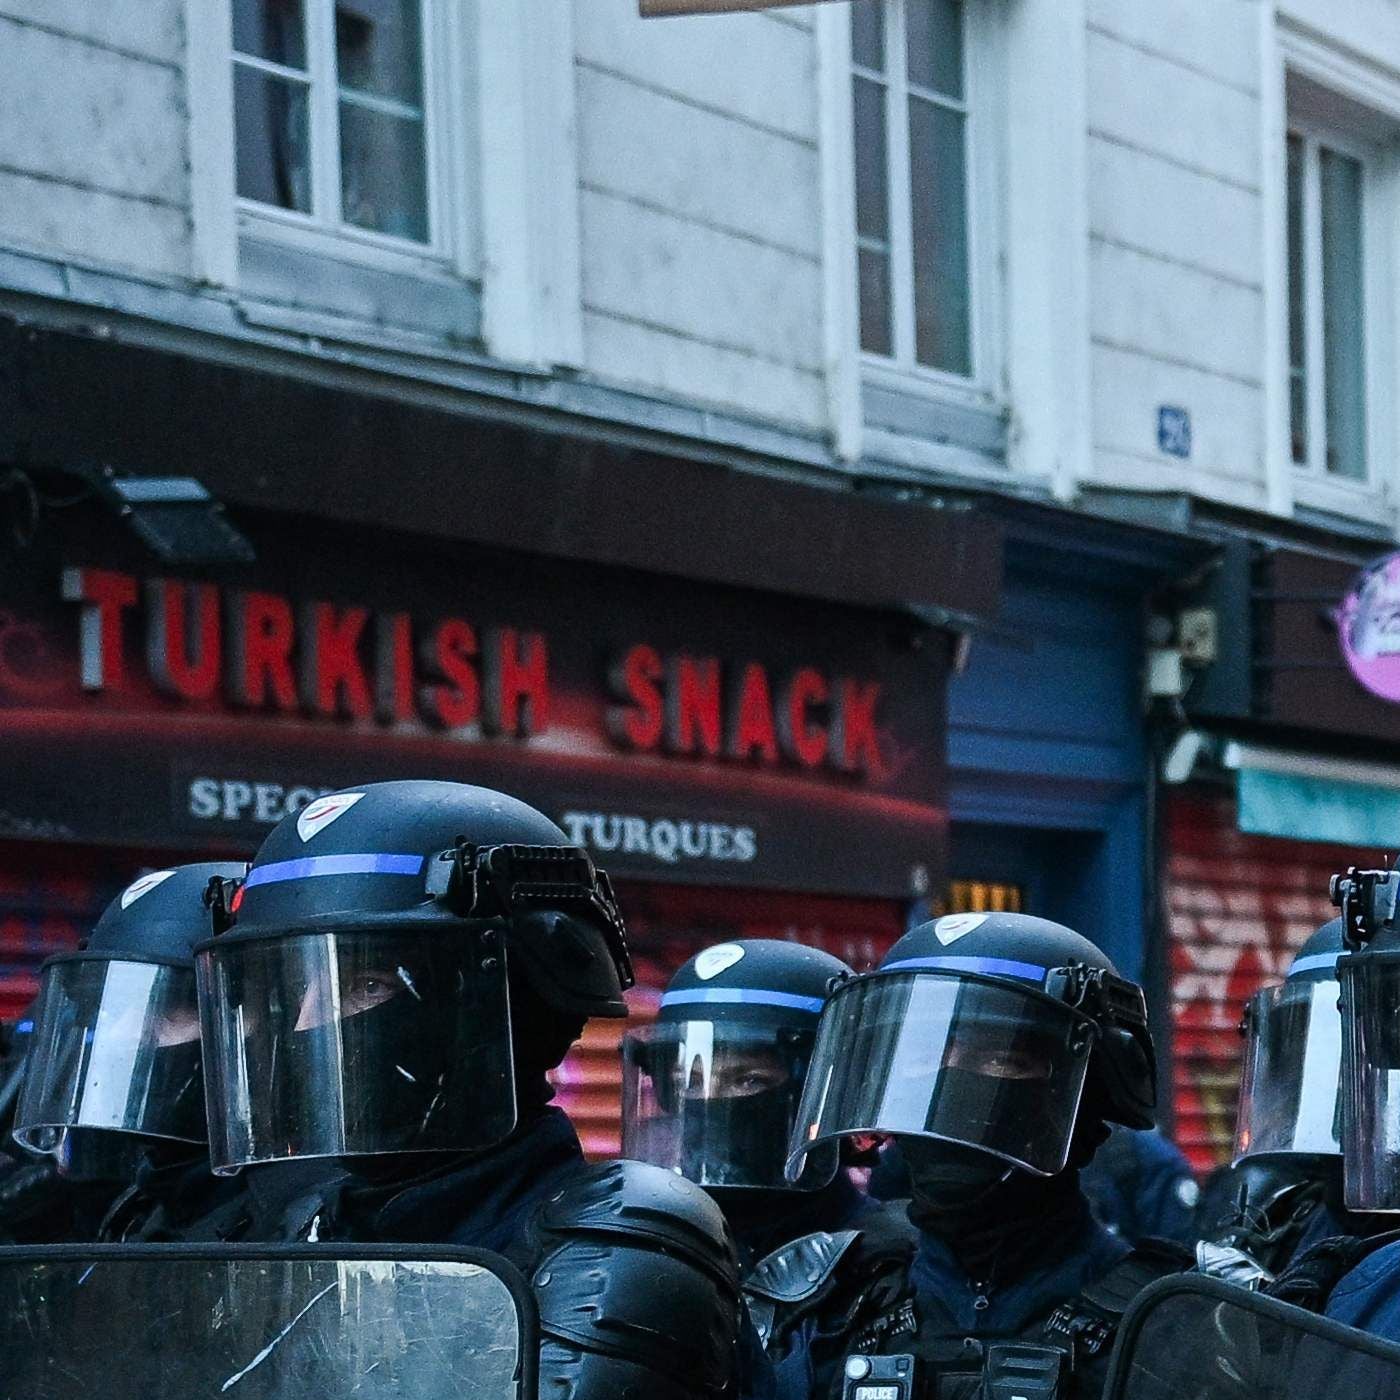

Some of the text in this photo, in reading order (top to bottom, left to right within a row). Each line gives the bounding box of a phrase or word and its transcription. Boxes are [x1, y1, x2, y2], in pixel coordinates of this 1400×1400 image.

[62, 566, 886, 778] TURKISH SNACK
[190, 778, 757, 864] SPEC TURQUES
[861, 1387, 895, 1400] POLICE
